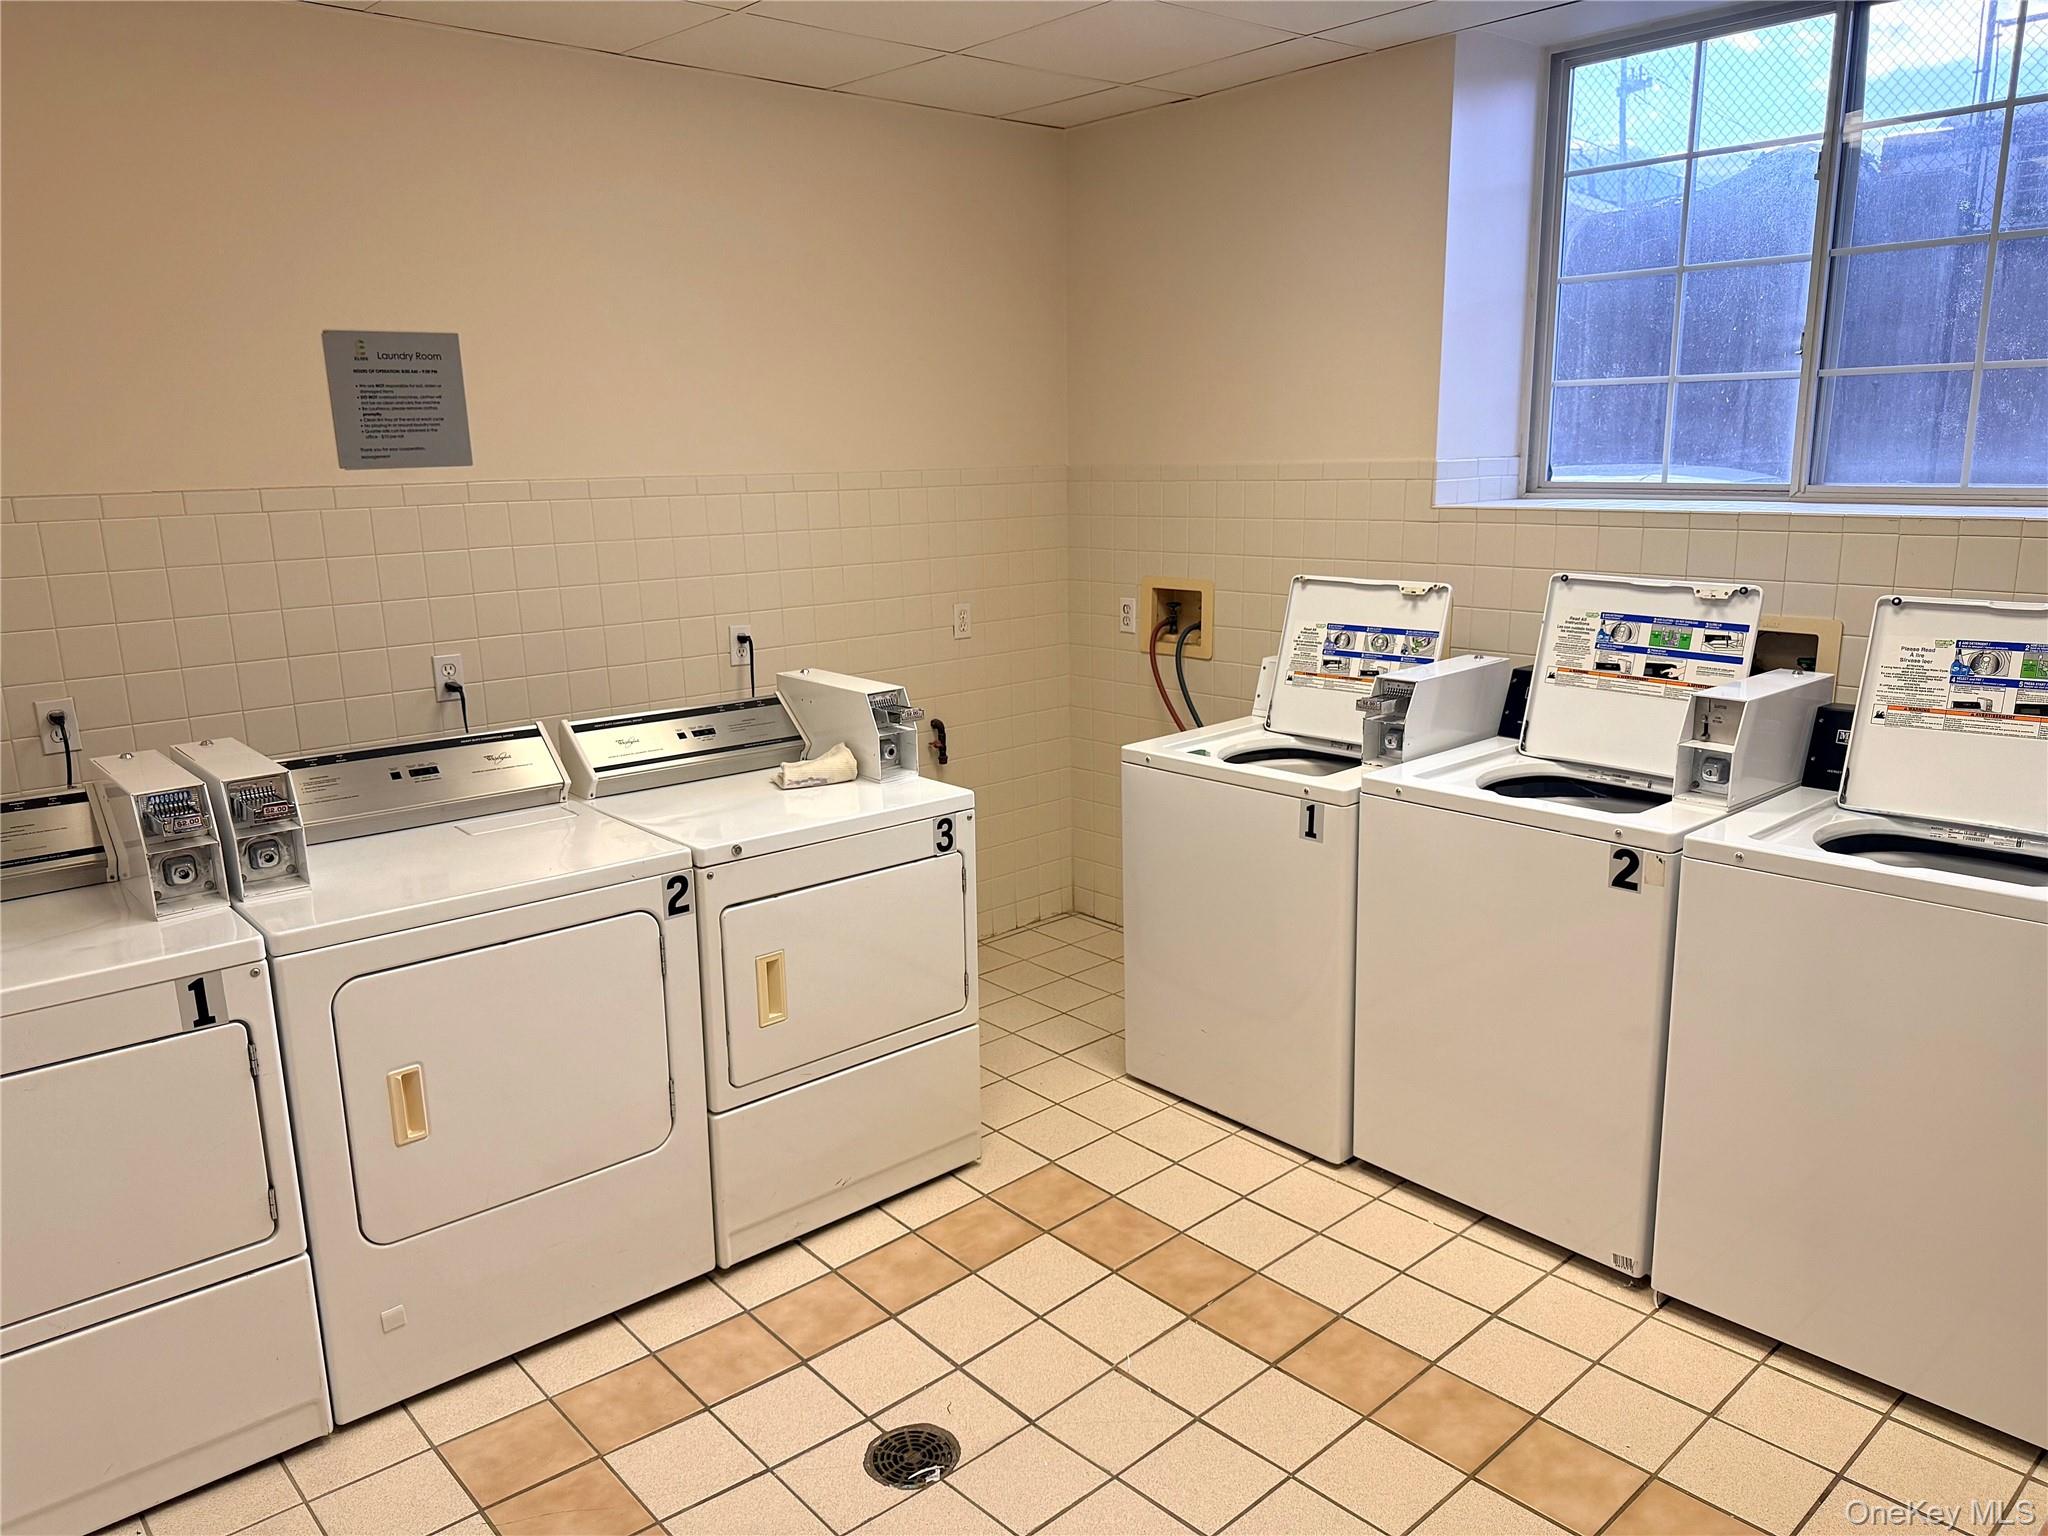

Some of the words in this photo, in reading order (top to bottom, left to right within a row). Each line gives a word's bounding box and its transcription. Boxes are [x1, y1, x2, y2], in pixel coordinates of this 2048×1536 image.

[377, 352, 413, 362] Laundry
[415, 352, 442, 360] Room
[2018, 680, 2024, 688] 5
[937, 817, 955, 852] 3
[1304, 804, 1317, 840] 1
[1611, 848, 1640, 892] 2
[666, 874, 691, 917] 2
[187, 977, 216, 1027] 1
